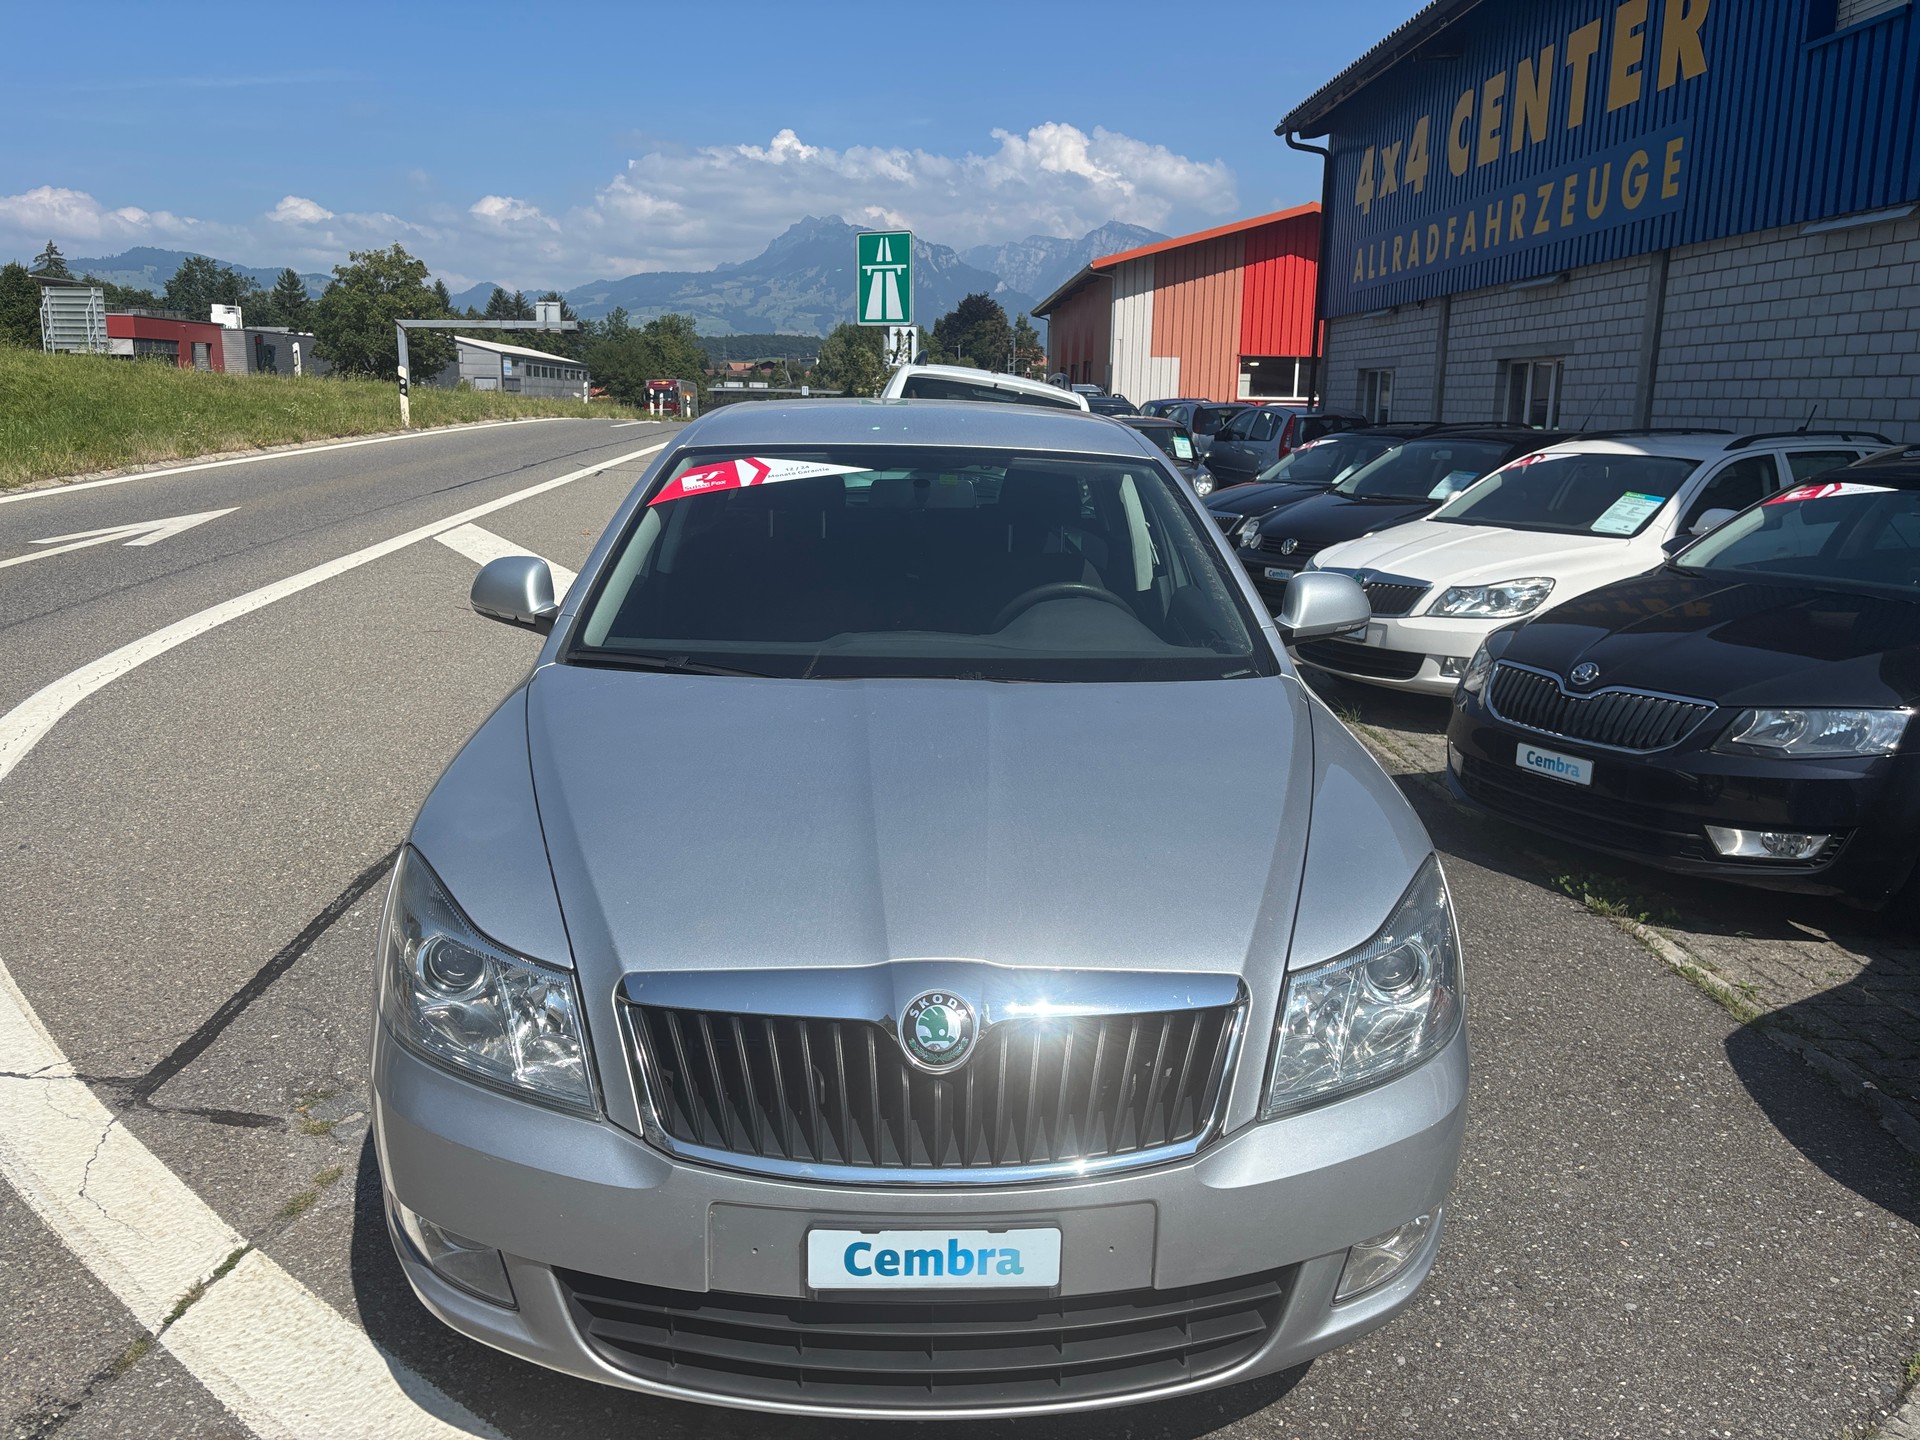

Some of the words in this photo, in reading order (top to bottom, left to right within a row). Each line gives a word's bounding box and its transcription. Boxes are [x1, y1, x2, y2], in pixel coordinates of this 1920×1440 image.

[1449, 0, 1708, 177] CENTER
[1353, 137, 1684, 284] ALLRADFAHRZEUGE
[1526, 750, 1580, 778] Cembra
[844, 1238, 1025, 1277] Cembra
